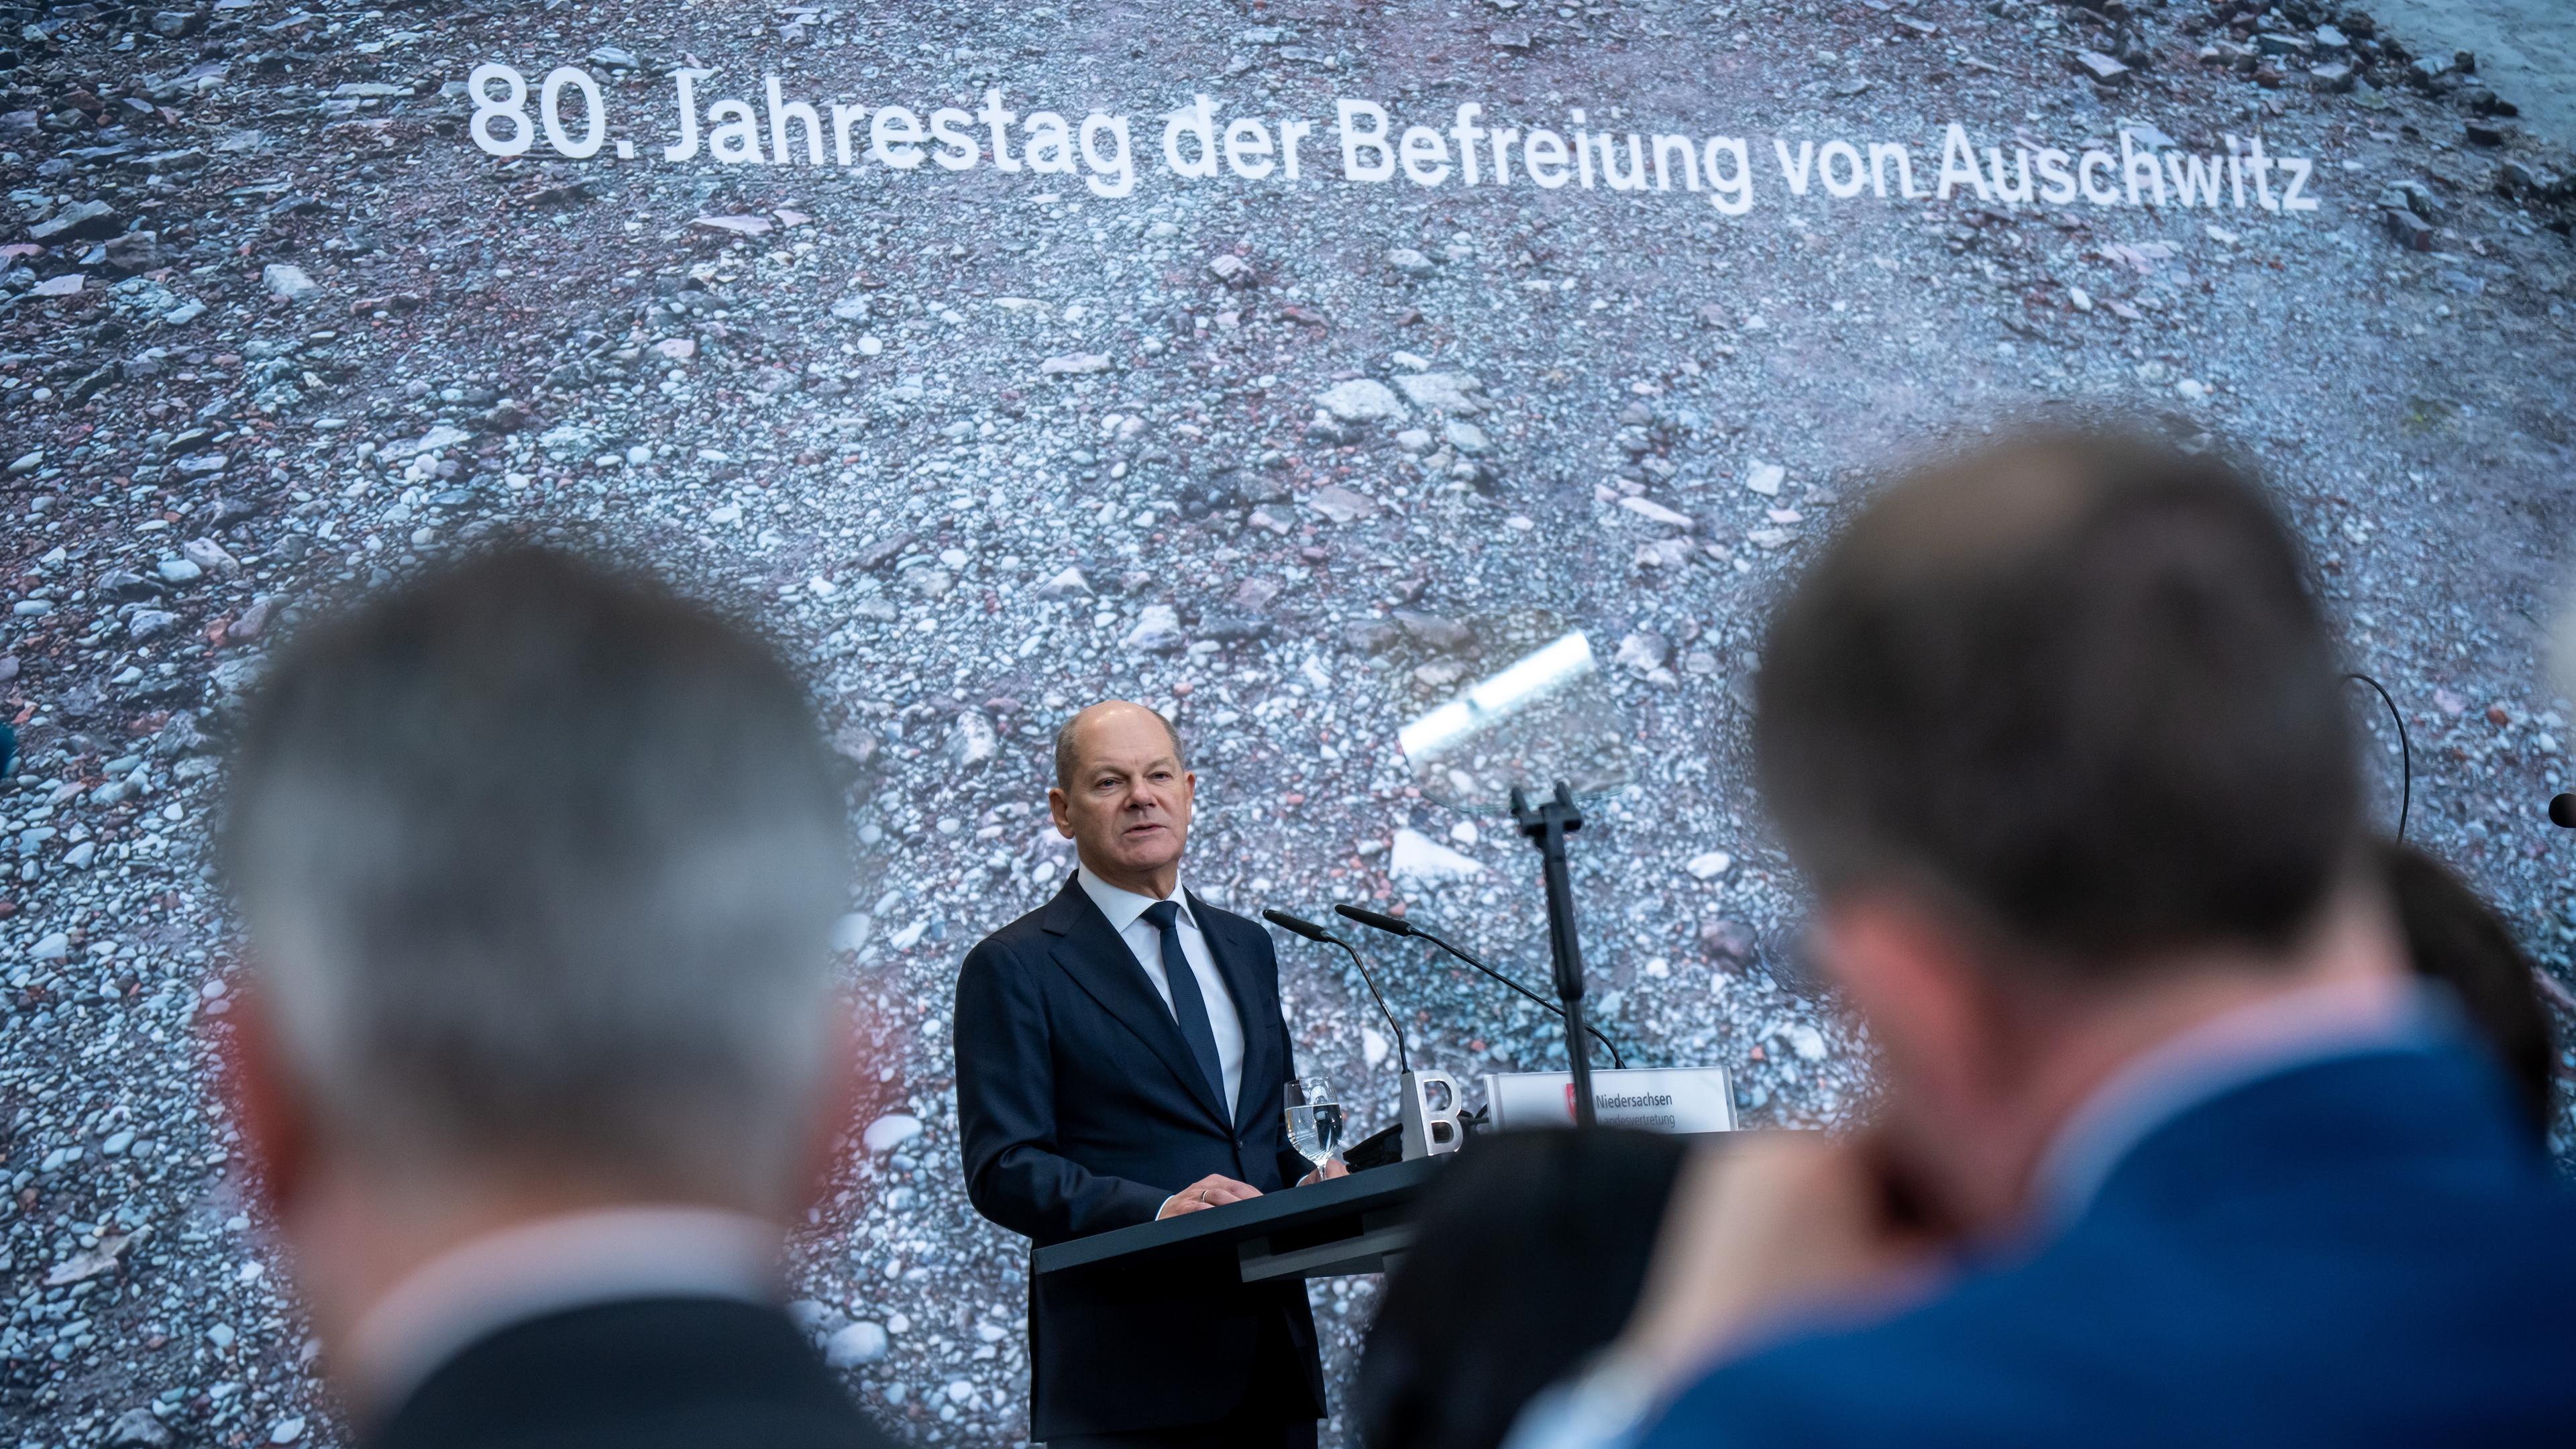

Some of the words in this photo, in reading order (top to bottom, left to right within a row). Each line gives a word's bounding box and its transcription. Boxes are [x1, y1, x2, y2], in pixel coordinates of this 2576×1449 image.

[468, 63, 635, 160] 80.
[664, 70, 1134, 199] Jahrestag
[1163, 94, 1311, 179] der
[1338, 99, 1753, 215] Befreiung
[1774, 140, 1915, 198] von
[1937, 123, 2318, 211] Auschwitz
[1596, 1091, 1672, 1109] Niedersachsen
